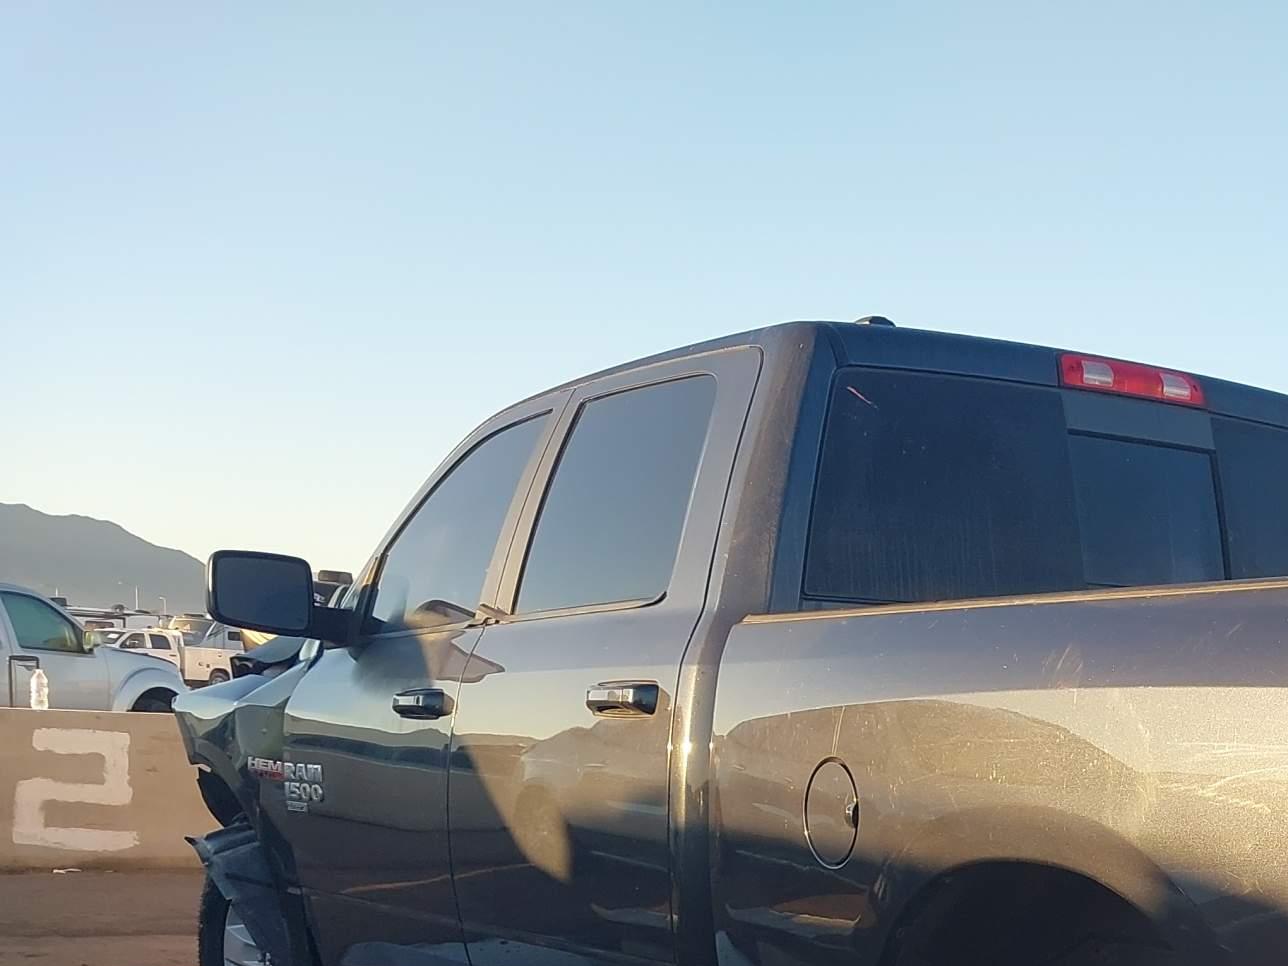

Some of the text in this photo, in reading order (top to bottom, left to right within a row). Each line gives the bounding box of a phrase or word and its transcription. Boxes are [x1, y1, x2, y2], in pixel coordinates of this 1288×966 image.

[247, 756, 283, 772] HEM
[284, 762, 322, 782] RAM
[12, 727, 140, 852] 2
[284, 782, 323, 801] 1500
